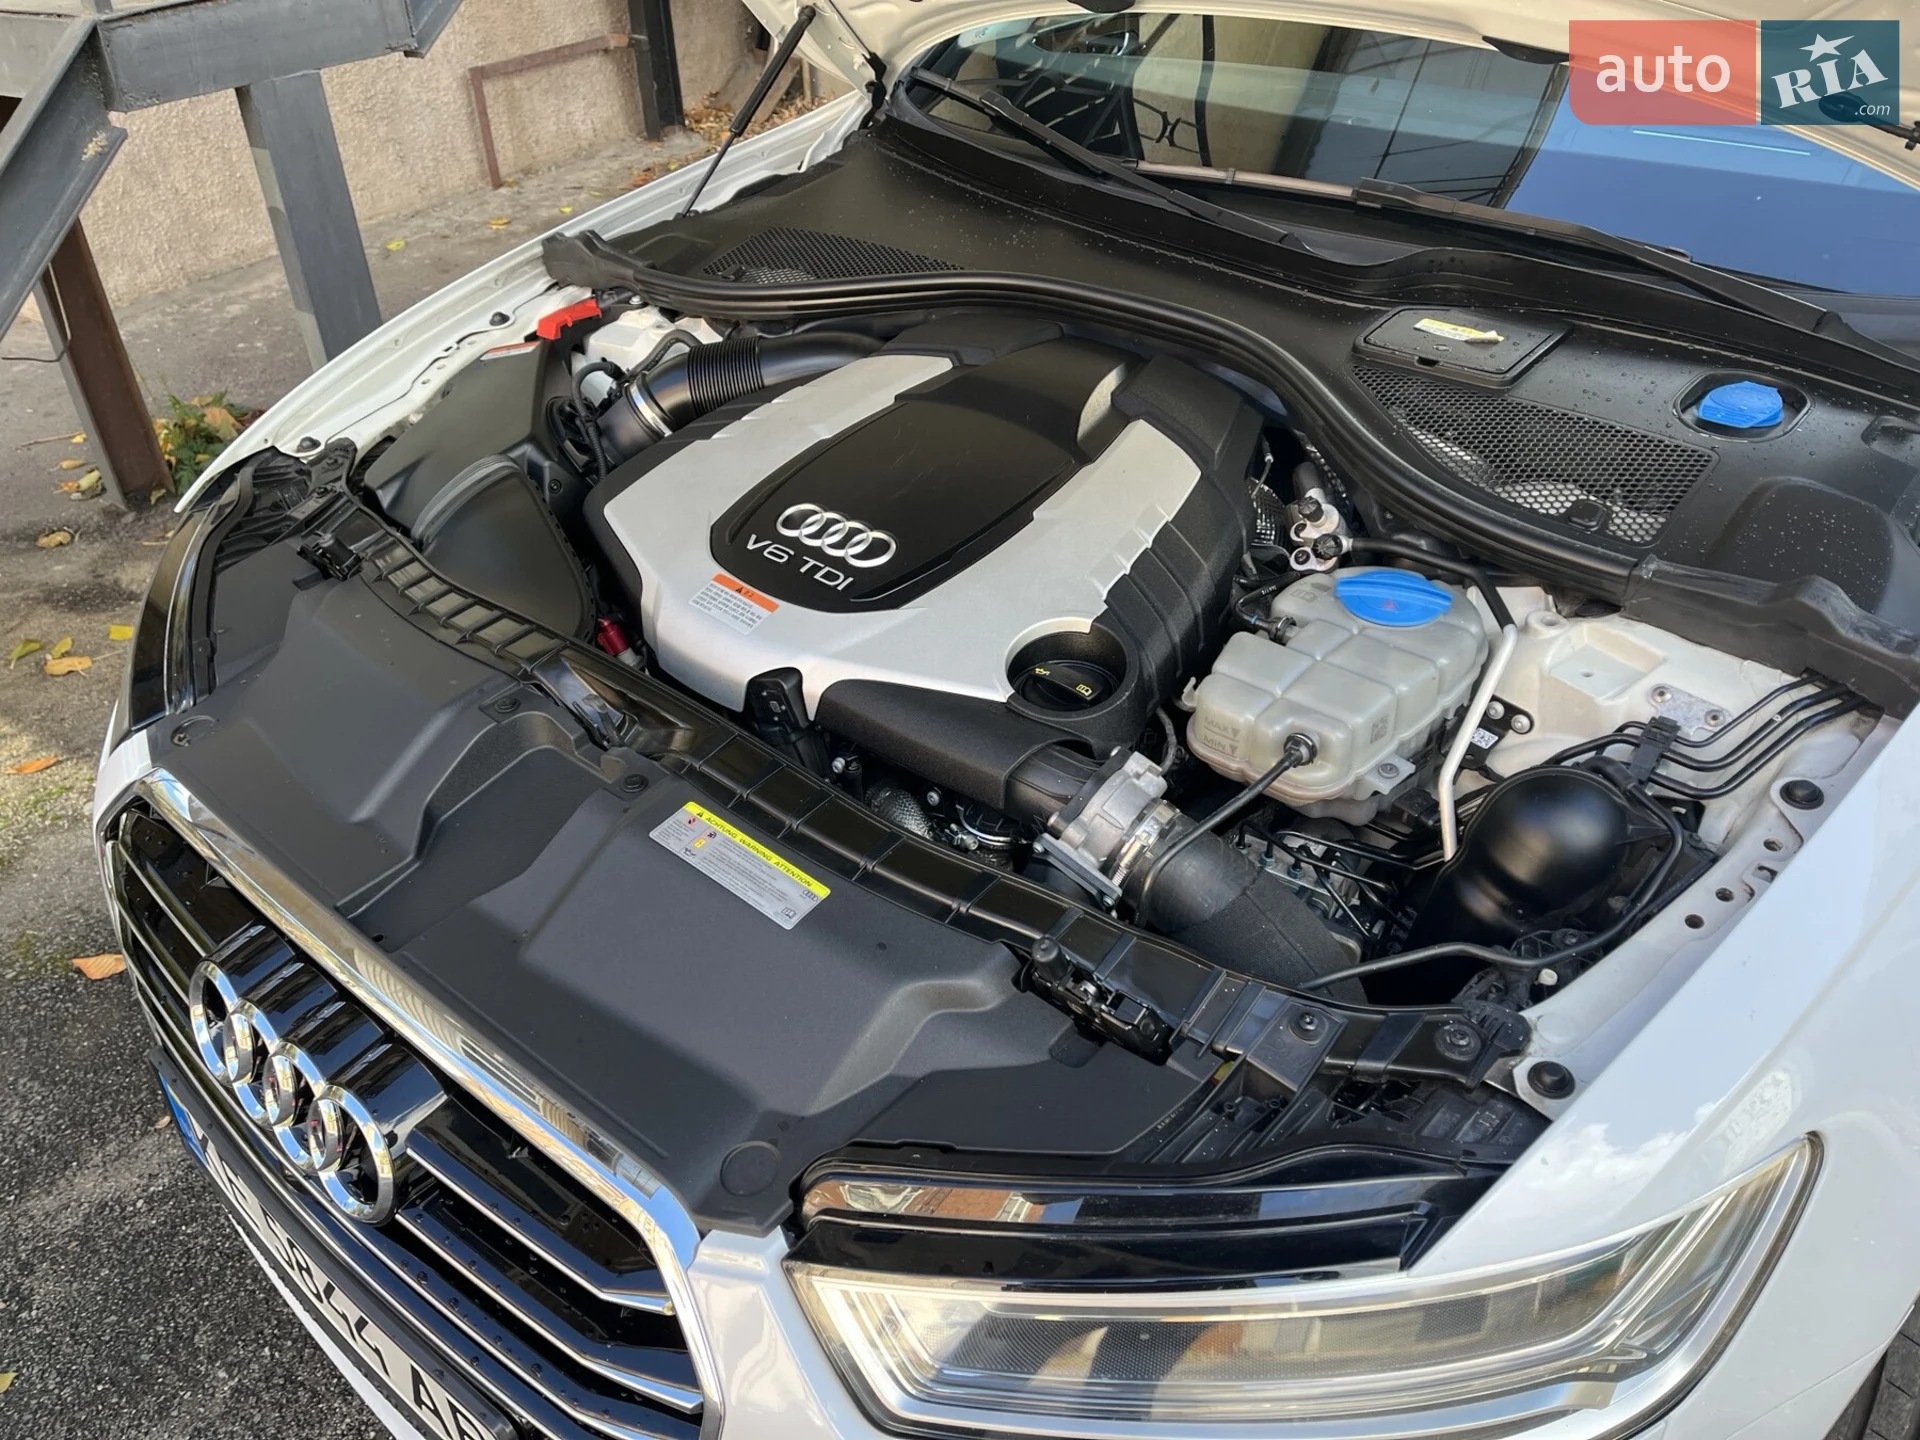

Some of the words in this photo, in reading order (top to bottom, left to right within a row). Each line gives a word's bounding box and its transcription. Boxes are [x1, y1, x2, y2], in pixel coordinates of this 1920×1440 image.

[746, 533, 795, 563] V6
[799, 555, 854, 591] TDI
[1203, 735, 1226, 751] MIN
[1204, 716, 1229, 734] MAX
[706, 817, 738, 839] ACHTUNG
[739, 838, 772, 862] WARNING
[773, 860, 813, 887] ATTENTION
